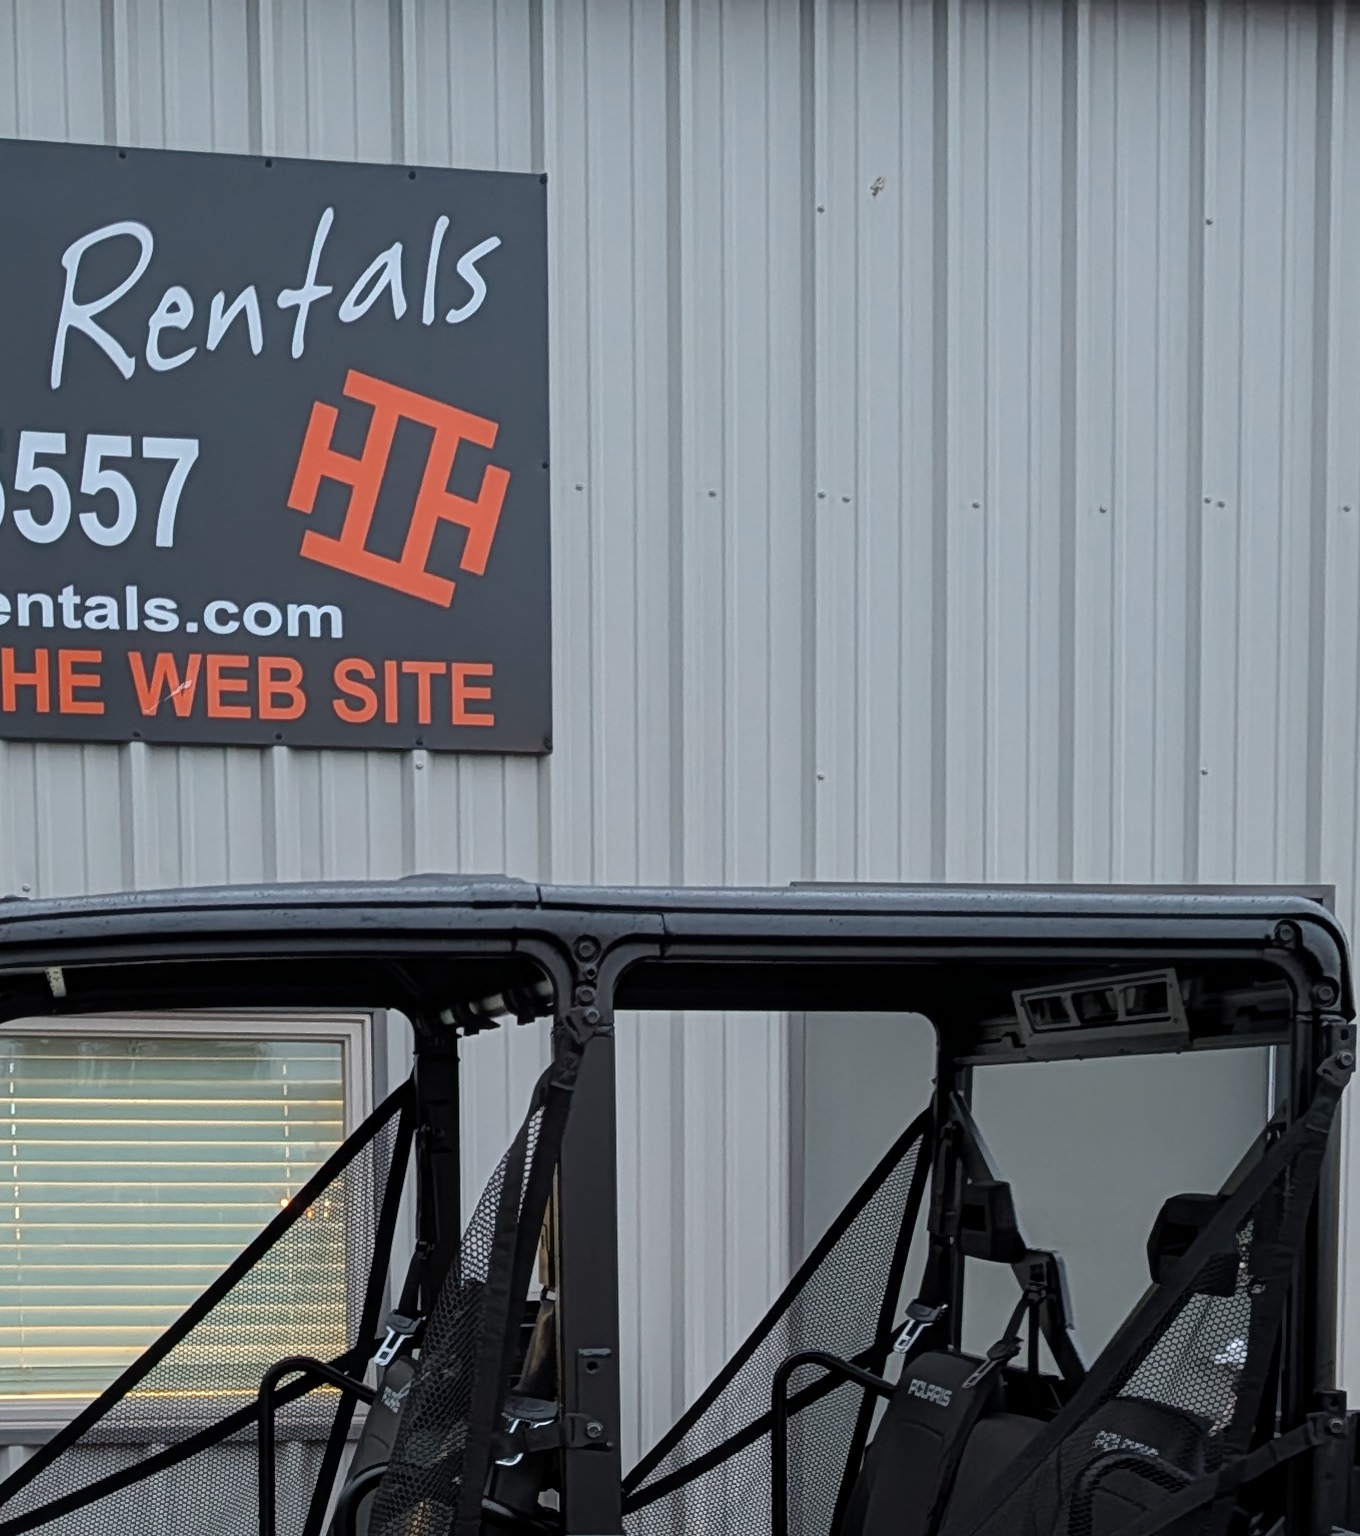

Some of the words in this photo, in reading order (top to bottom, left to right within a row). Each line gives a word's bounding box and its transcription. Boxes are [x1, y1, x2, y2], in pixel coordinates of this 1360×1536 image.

[51, 206, 502, 388] Rentals
[126, 652, 307, 721] WEB
[331, 658, 495, 727] SITE
[908, 1378, 953, 1407] POLARIS
